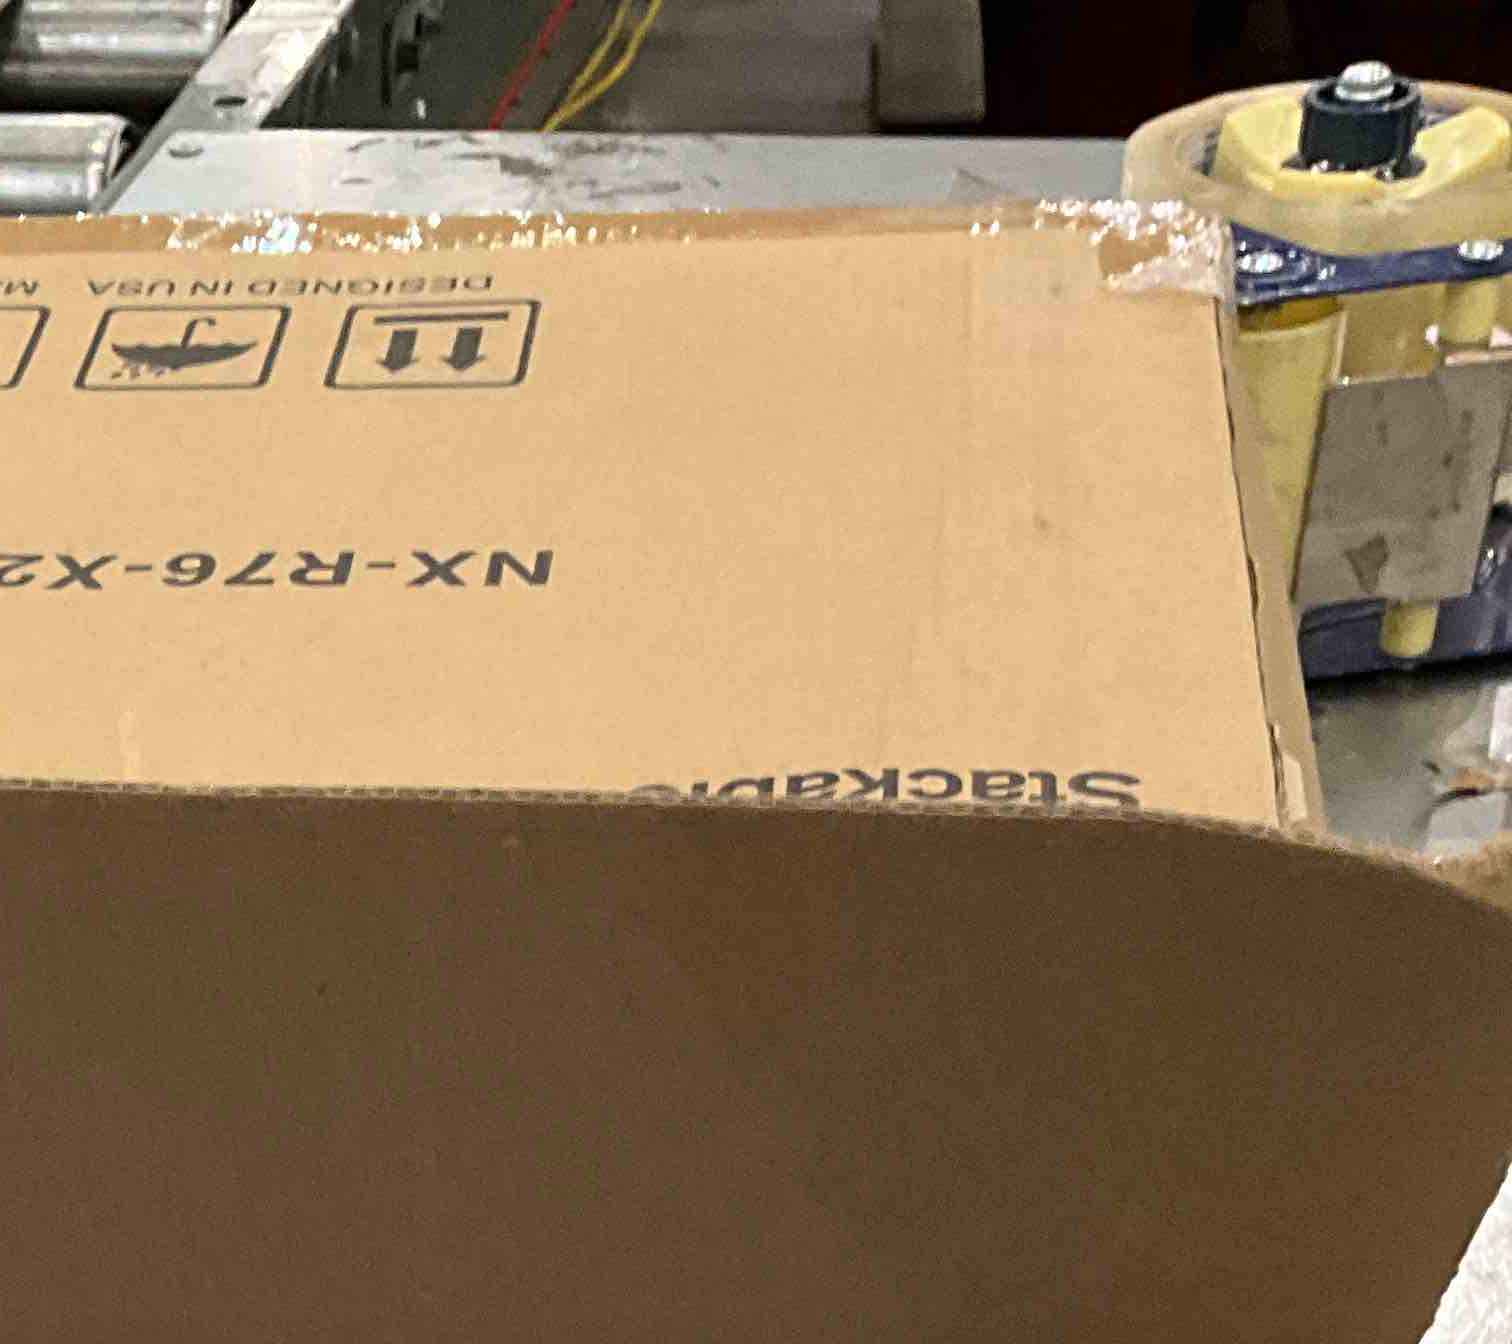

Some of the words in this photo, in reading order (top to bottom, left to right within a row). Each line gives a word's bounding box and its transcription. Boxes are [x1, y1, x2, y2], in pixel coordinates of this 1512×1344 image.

[87, 278, 178, 298] USA
[187, 277, 235, 297] IN
[246, 273, 496, 297] DESIGNED
